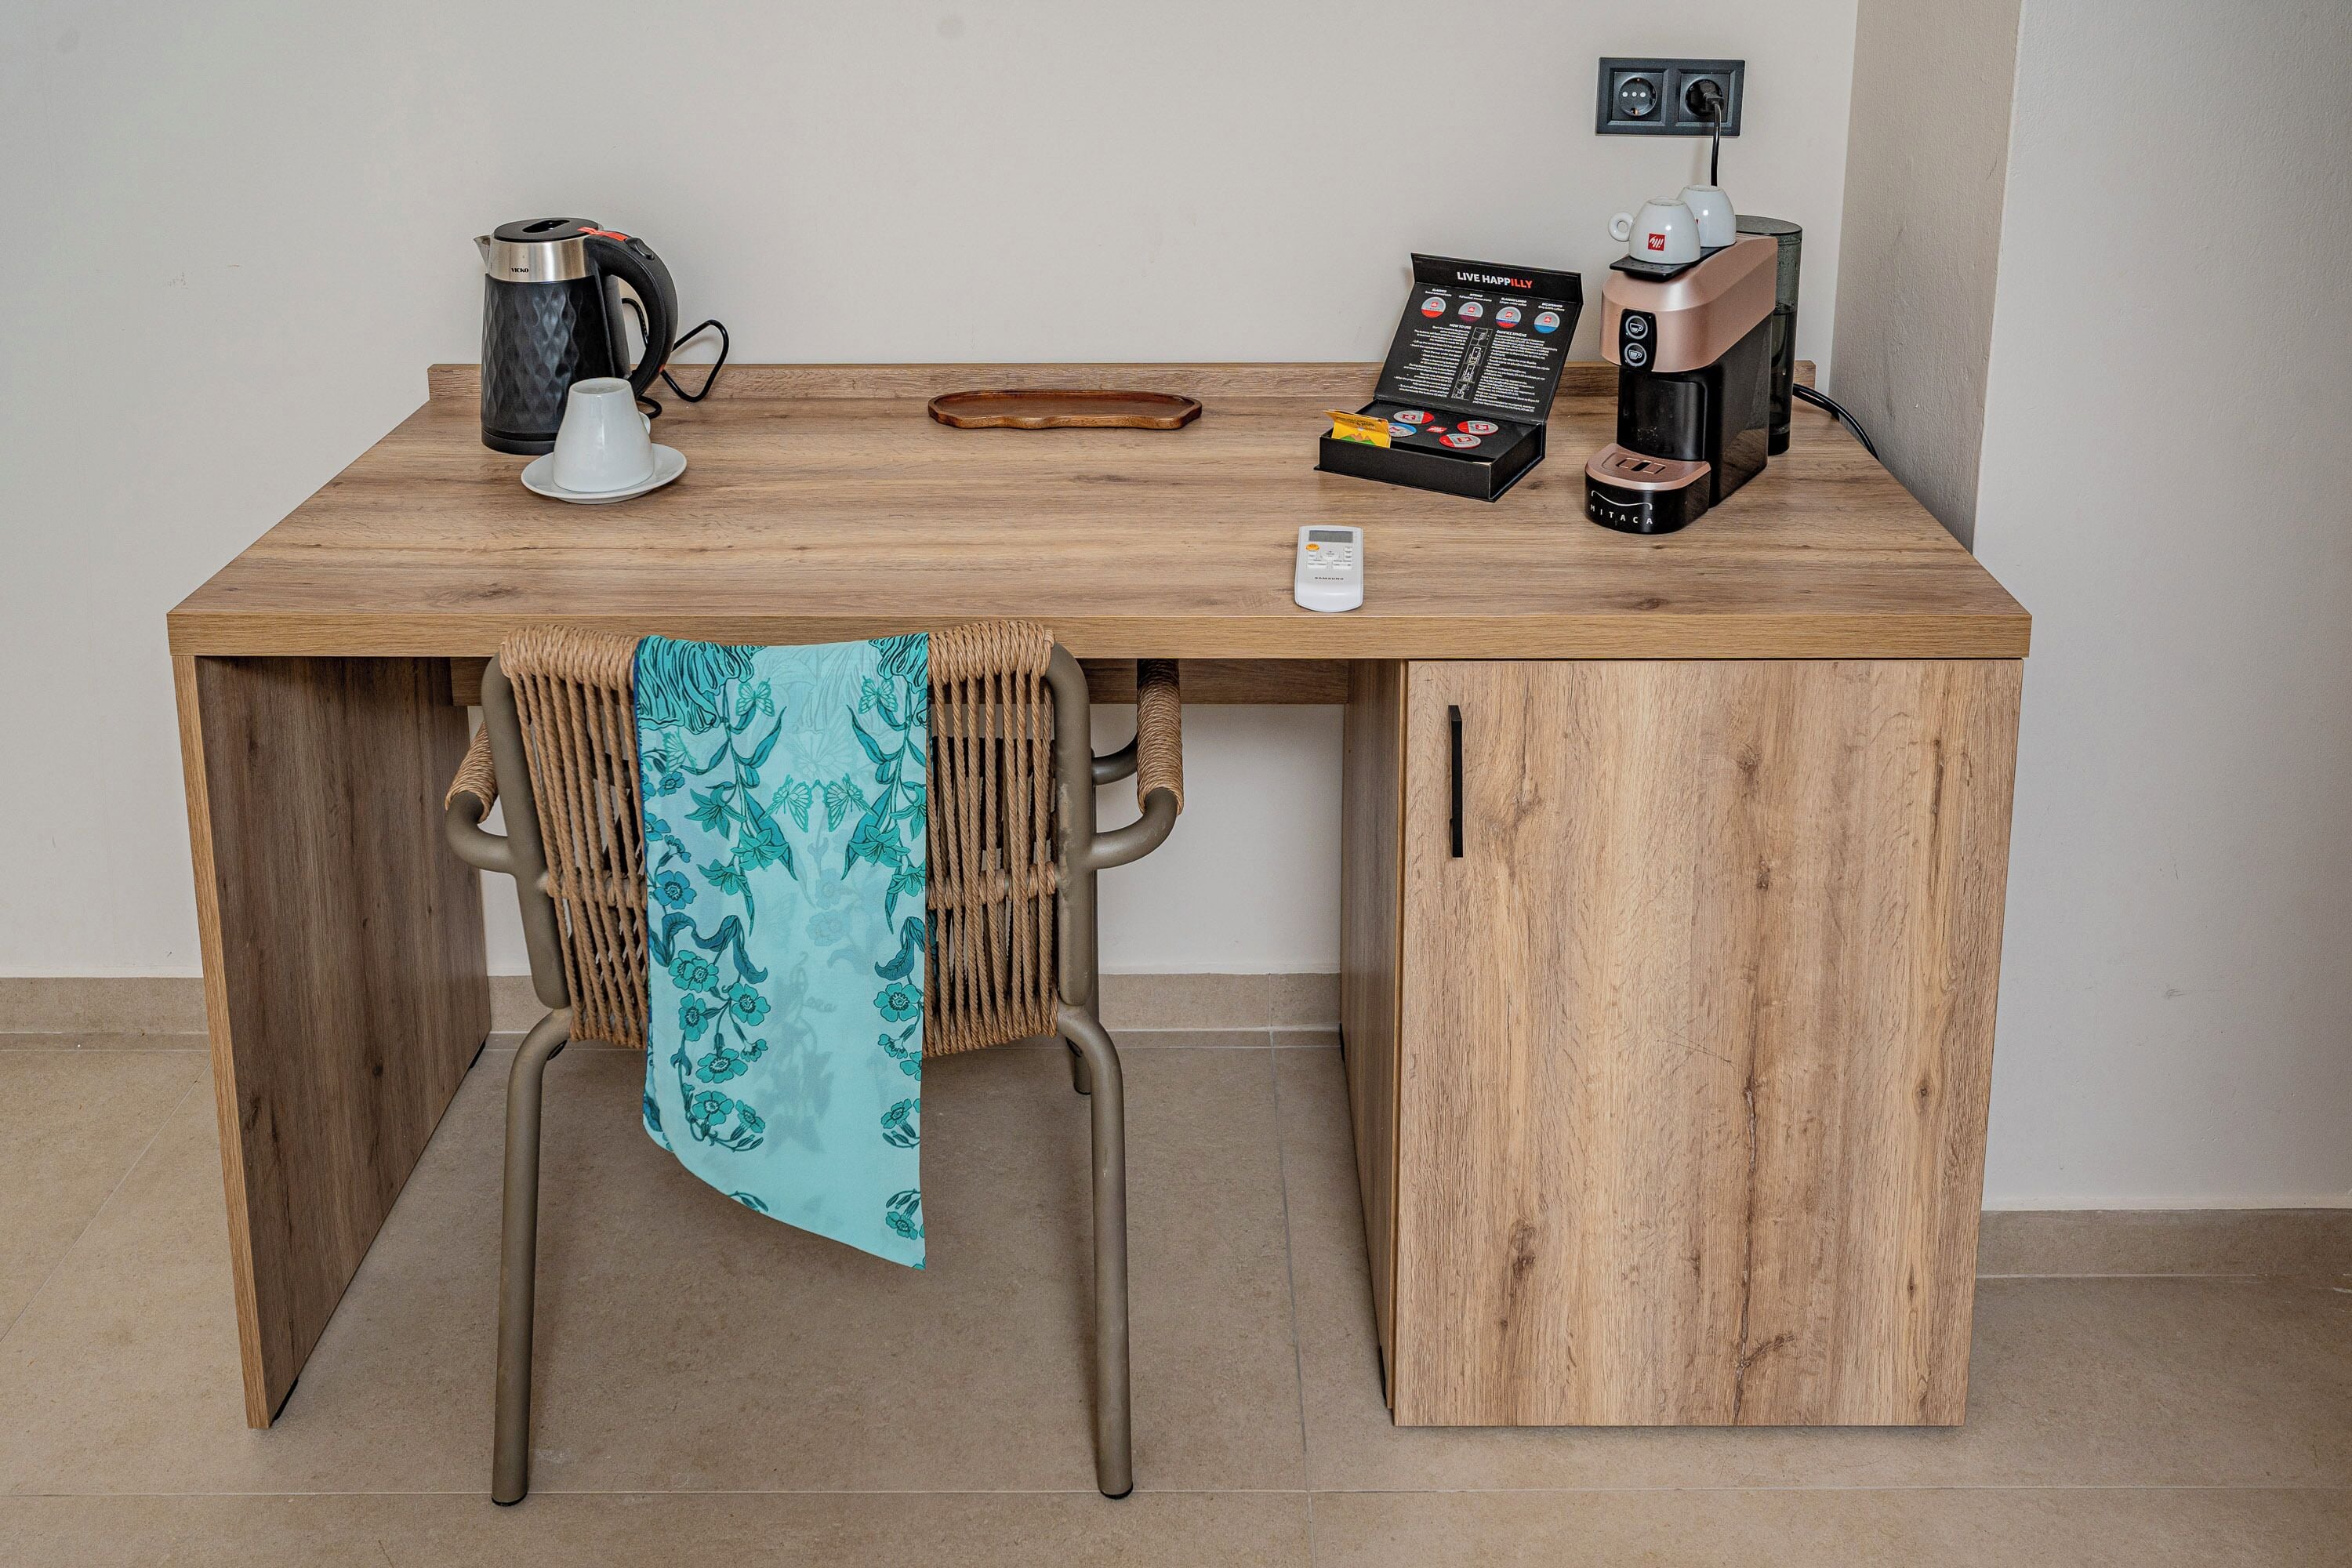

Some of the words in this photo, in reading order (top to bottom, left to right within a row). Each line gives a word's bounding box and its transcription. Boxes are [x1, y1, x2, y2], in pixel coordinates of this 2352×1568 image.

[1457, 272, 1480, 282] LIVE
[1482, 275, 1532, 289] HAPPILLY
[1590, 504, 1653, 524] MITACA
